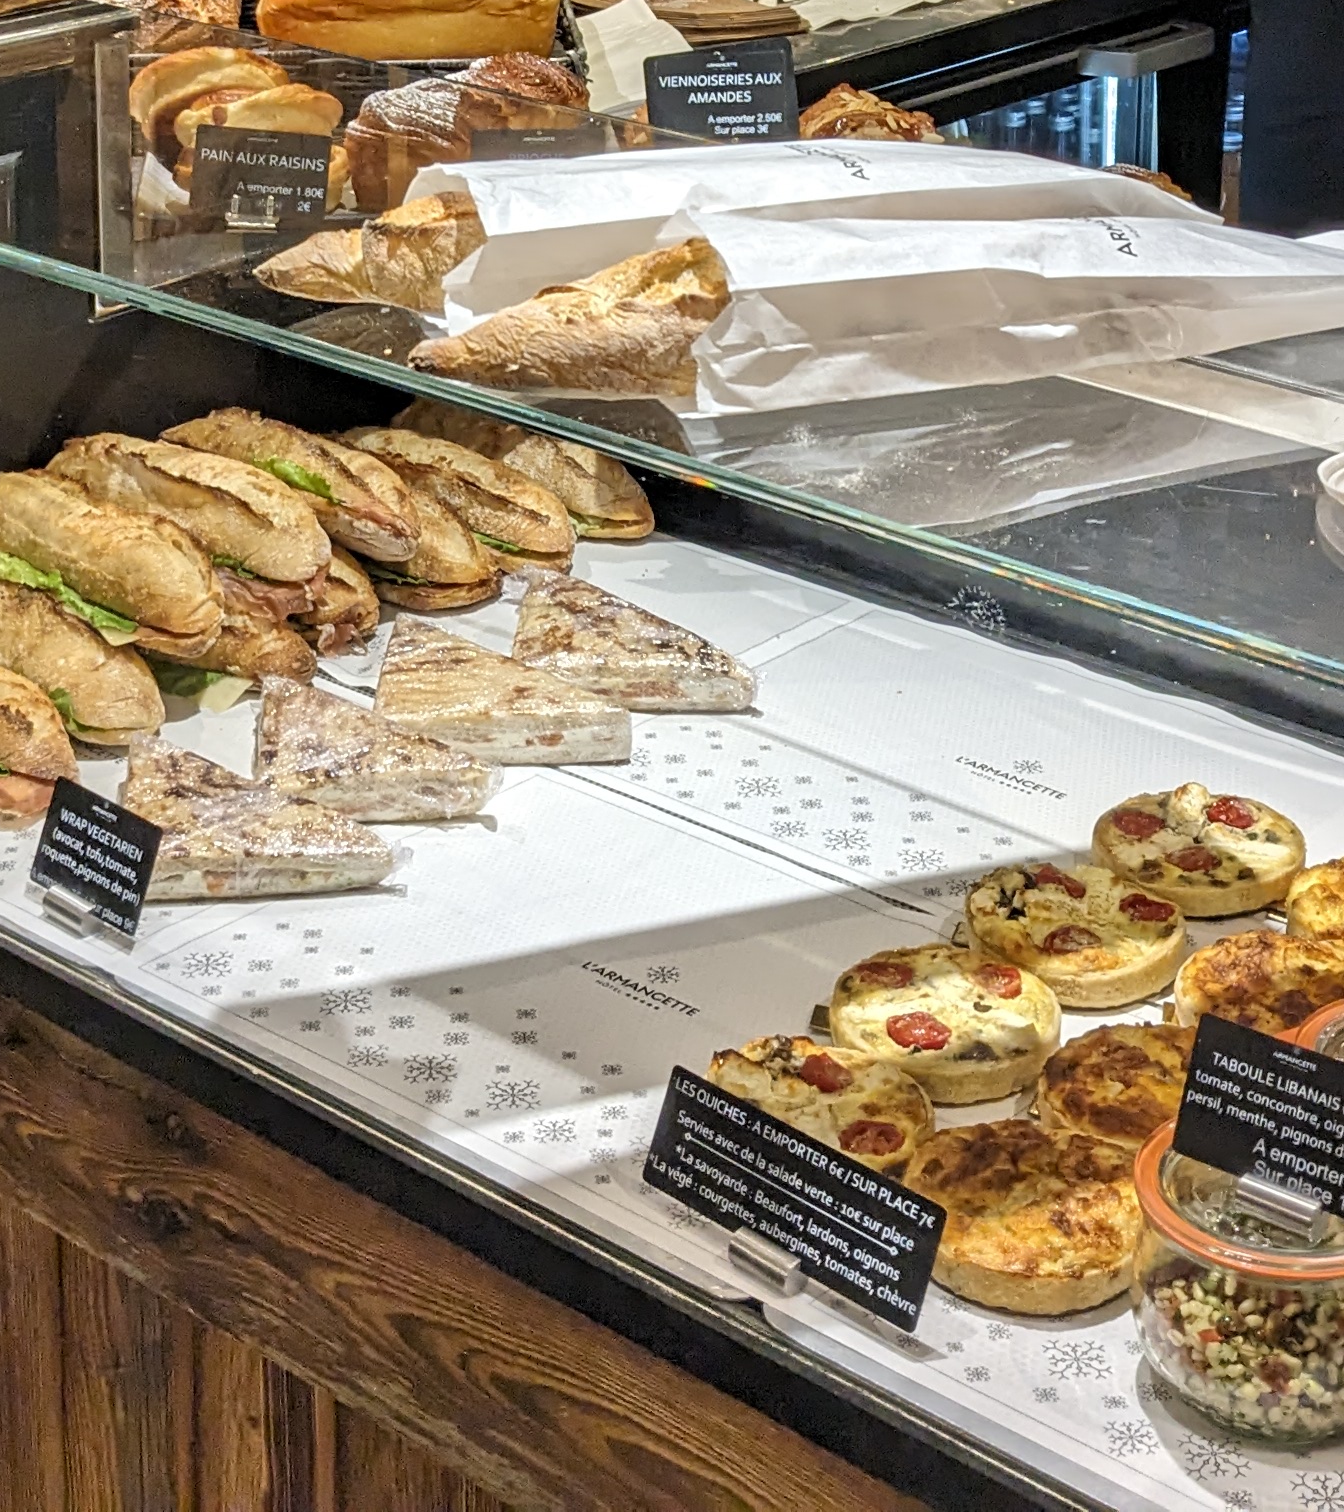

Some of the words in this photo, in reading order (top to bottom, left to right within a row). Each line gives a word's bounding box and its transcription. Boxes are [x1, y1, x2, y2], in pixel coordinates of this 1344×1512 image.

[658, 74, 753, 88] VIENNOISERIES
[755, 73, 782, 85] AUX
[687, 90, 752, 104] AMANDES
[707, 115, 716, 124] A
[716, 114, 756, 124] emporter
[756, 113, 783, 123] 2.50€
[714, 125, 730, 135] Sur
[732, 124, 755, 136] place
[757, 124, 769, 134] 3€
[201, 148, 234, 163] PAIN
[236, 154, 266, 167] AUX
[269, 155, 327, 172] RAISINS
[247, 184, 293, 196] emporter
[955, 755, 1067, 800] L'ARMANCETTE
[53, 827, 84, 856] (avocat,
[60, 808, 88, 832] WRAP
[87, 822, 144, 863] VEGETARIEN
[111, 880, 123, 896] de
[121, 888, 141, 907] pin)
[581, 961, 700, 1017] L'ARMANCETTE
[1194, 1068, 1244, 1100] tomate,
[1246, 1090, 1321, 1130] concombre,
[1212, 1051, 1276, 1088] TABOULE
[1276, 1076, 1341, 1111] LIBANAIS
[1186, 1089, 1224, 1115] persil,
[1226, 1103, 1279, 1136] menthe,
[1280, 1125, 1333, 1154] pignons
[675, 1076, 696, 1100] LES
[696, 1089, 748, 1126] QUICHES
[752, 1118, 762, 1135] A
[762, 1124, 828, 1168] EMPORTER
[828, 1160, 845, 1181] 6€
[850, 1172, 877, 1196] SUR
[877, 1188, 921, 1218] PLACE
[920, 1210, 936, 1229] 7€
[1253, 1138, 1266, 1156] A
[677, 1110, 715, 1141] Servies
[715, 1134, 740, 1154] avec
[740, 1146, 755, 1164] de
[756, 1152, 766, 1168] la
[766, 1161, 804, 1190] salade
[803, 1181, 834, 1206] verte
[839, 1203, 862, 1226] 10€
[862, 1214, 883, 1234] sur
[880, 1224, 915, 1258] place
[1254, 1159, 1284, 1183] Sur
[1286, 1174, 1333, 1205] place
[667, 1162, 693, 1190] végé
[698, 1186, 758, 1230] courgettes,
[758, 1218, 824, 1266] aubergines,
[824, 1256, 874, 1296] tomates,
[876, 1284, 917, 1316] chèvre
[694, 1156, 748, 1196] savoyarde
[754, 1190, 805, 1232] Beaufort,
[806, 1220, 851, 1261] lardons,
[852, 1249, 901, 1282] oignons
